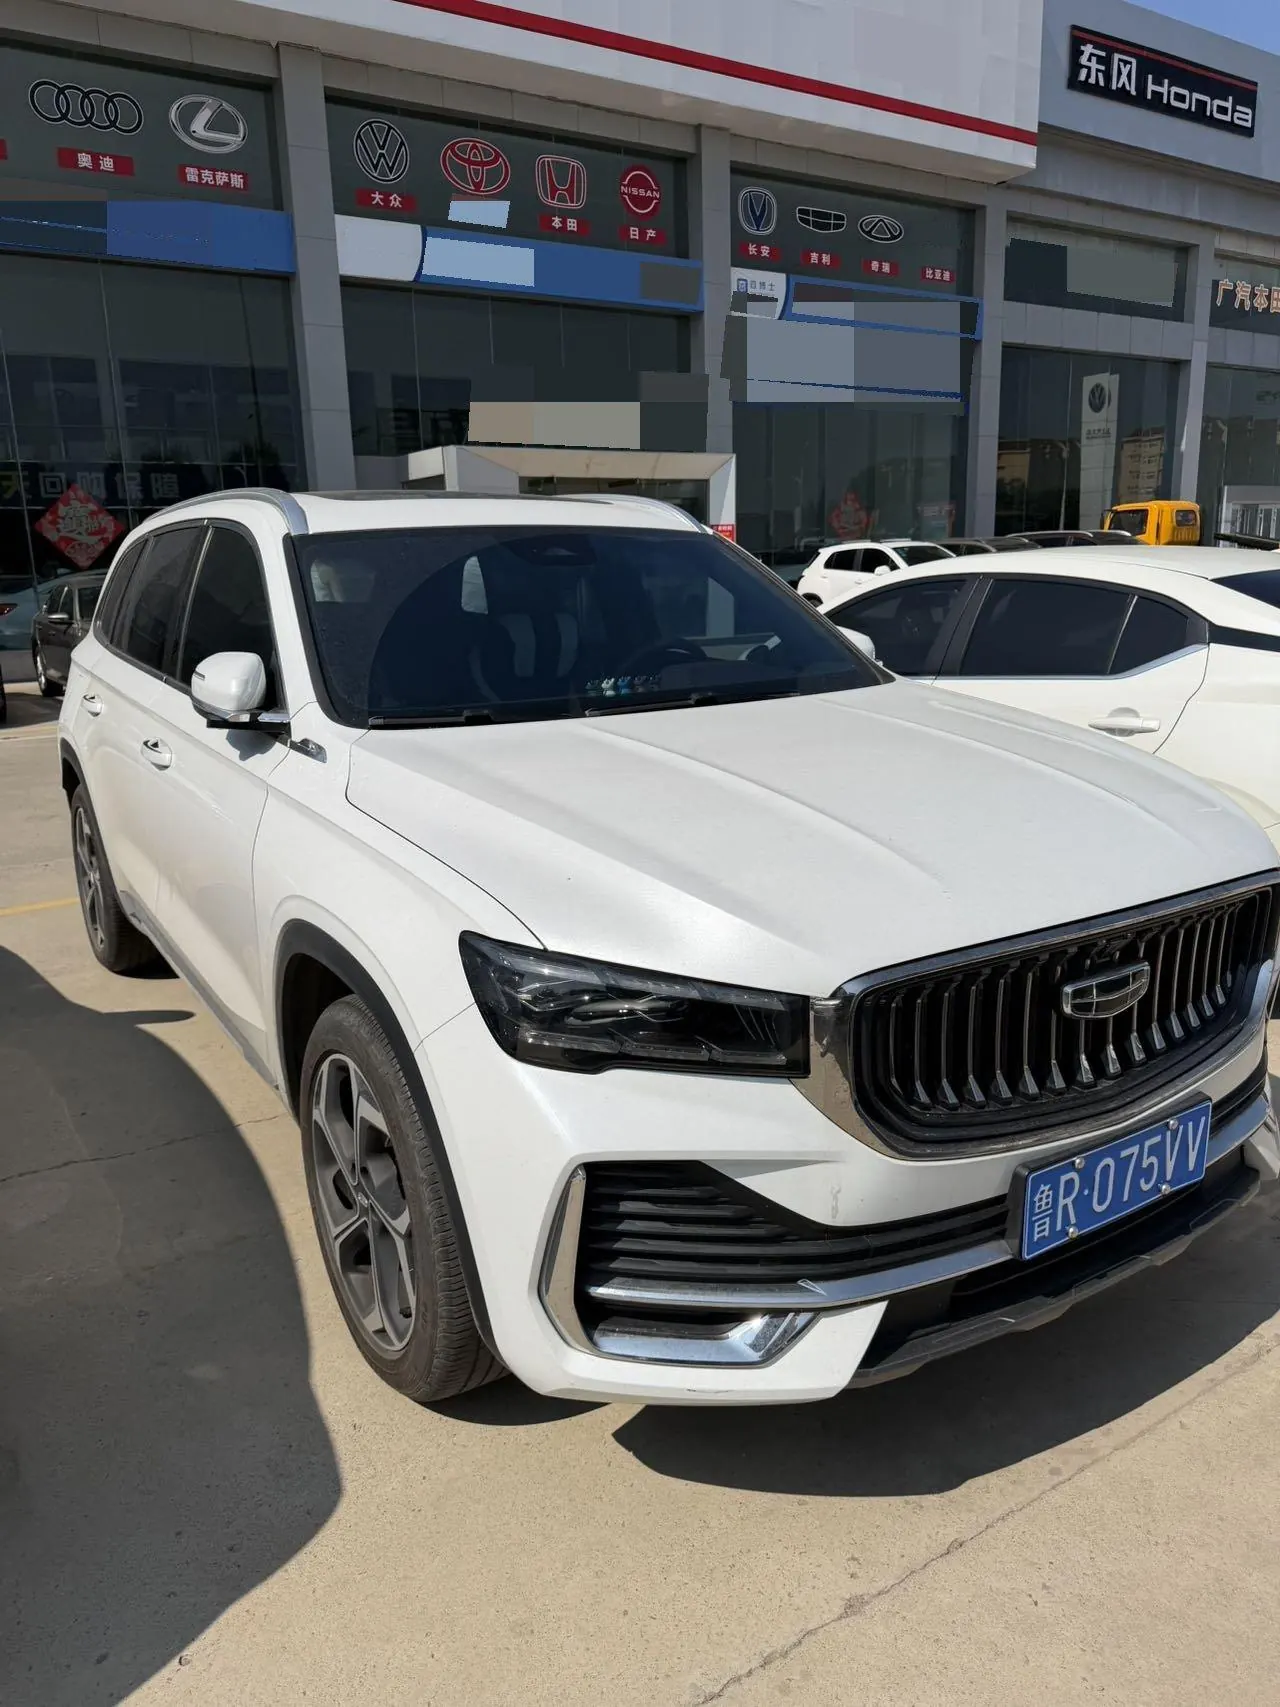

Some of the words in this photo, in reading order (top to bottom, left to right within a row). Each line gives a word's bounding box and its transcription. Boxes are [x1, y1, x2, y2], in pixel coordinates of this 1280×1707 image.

[1078, 44, 1137, 96] 东风
[1146, 74, 1253, 128] Honda
[77, 152, 116, 172] 奥迪
[184, 166, 245, 189] 雷克萨斯
[371, 191, 403, 208] 大众
[620, 185, 660, 199] NISSAN
[551, 216, 577, 232] 本田
[629, 227, 657, 241] 日产
[748, 243, 771, 257] 长安
[810, 252, 831, 266] 吉利
[925, 268, 951, 282] 比亚迪
